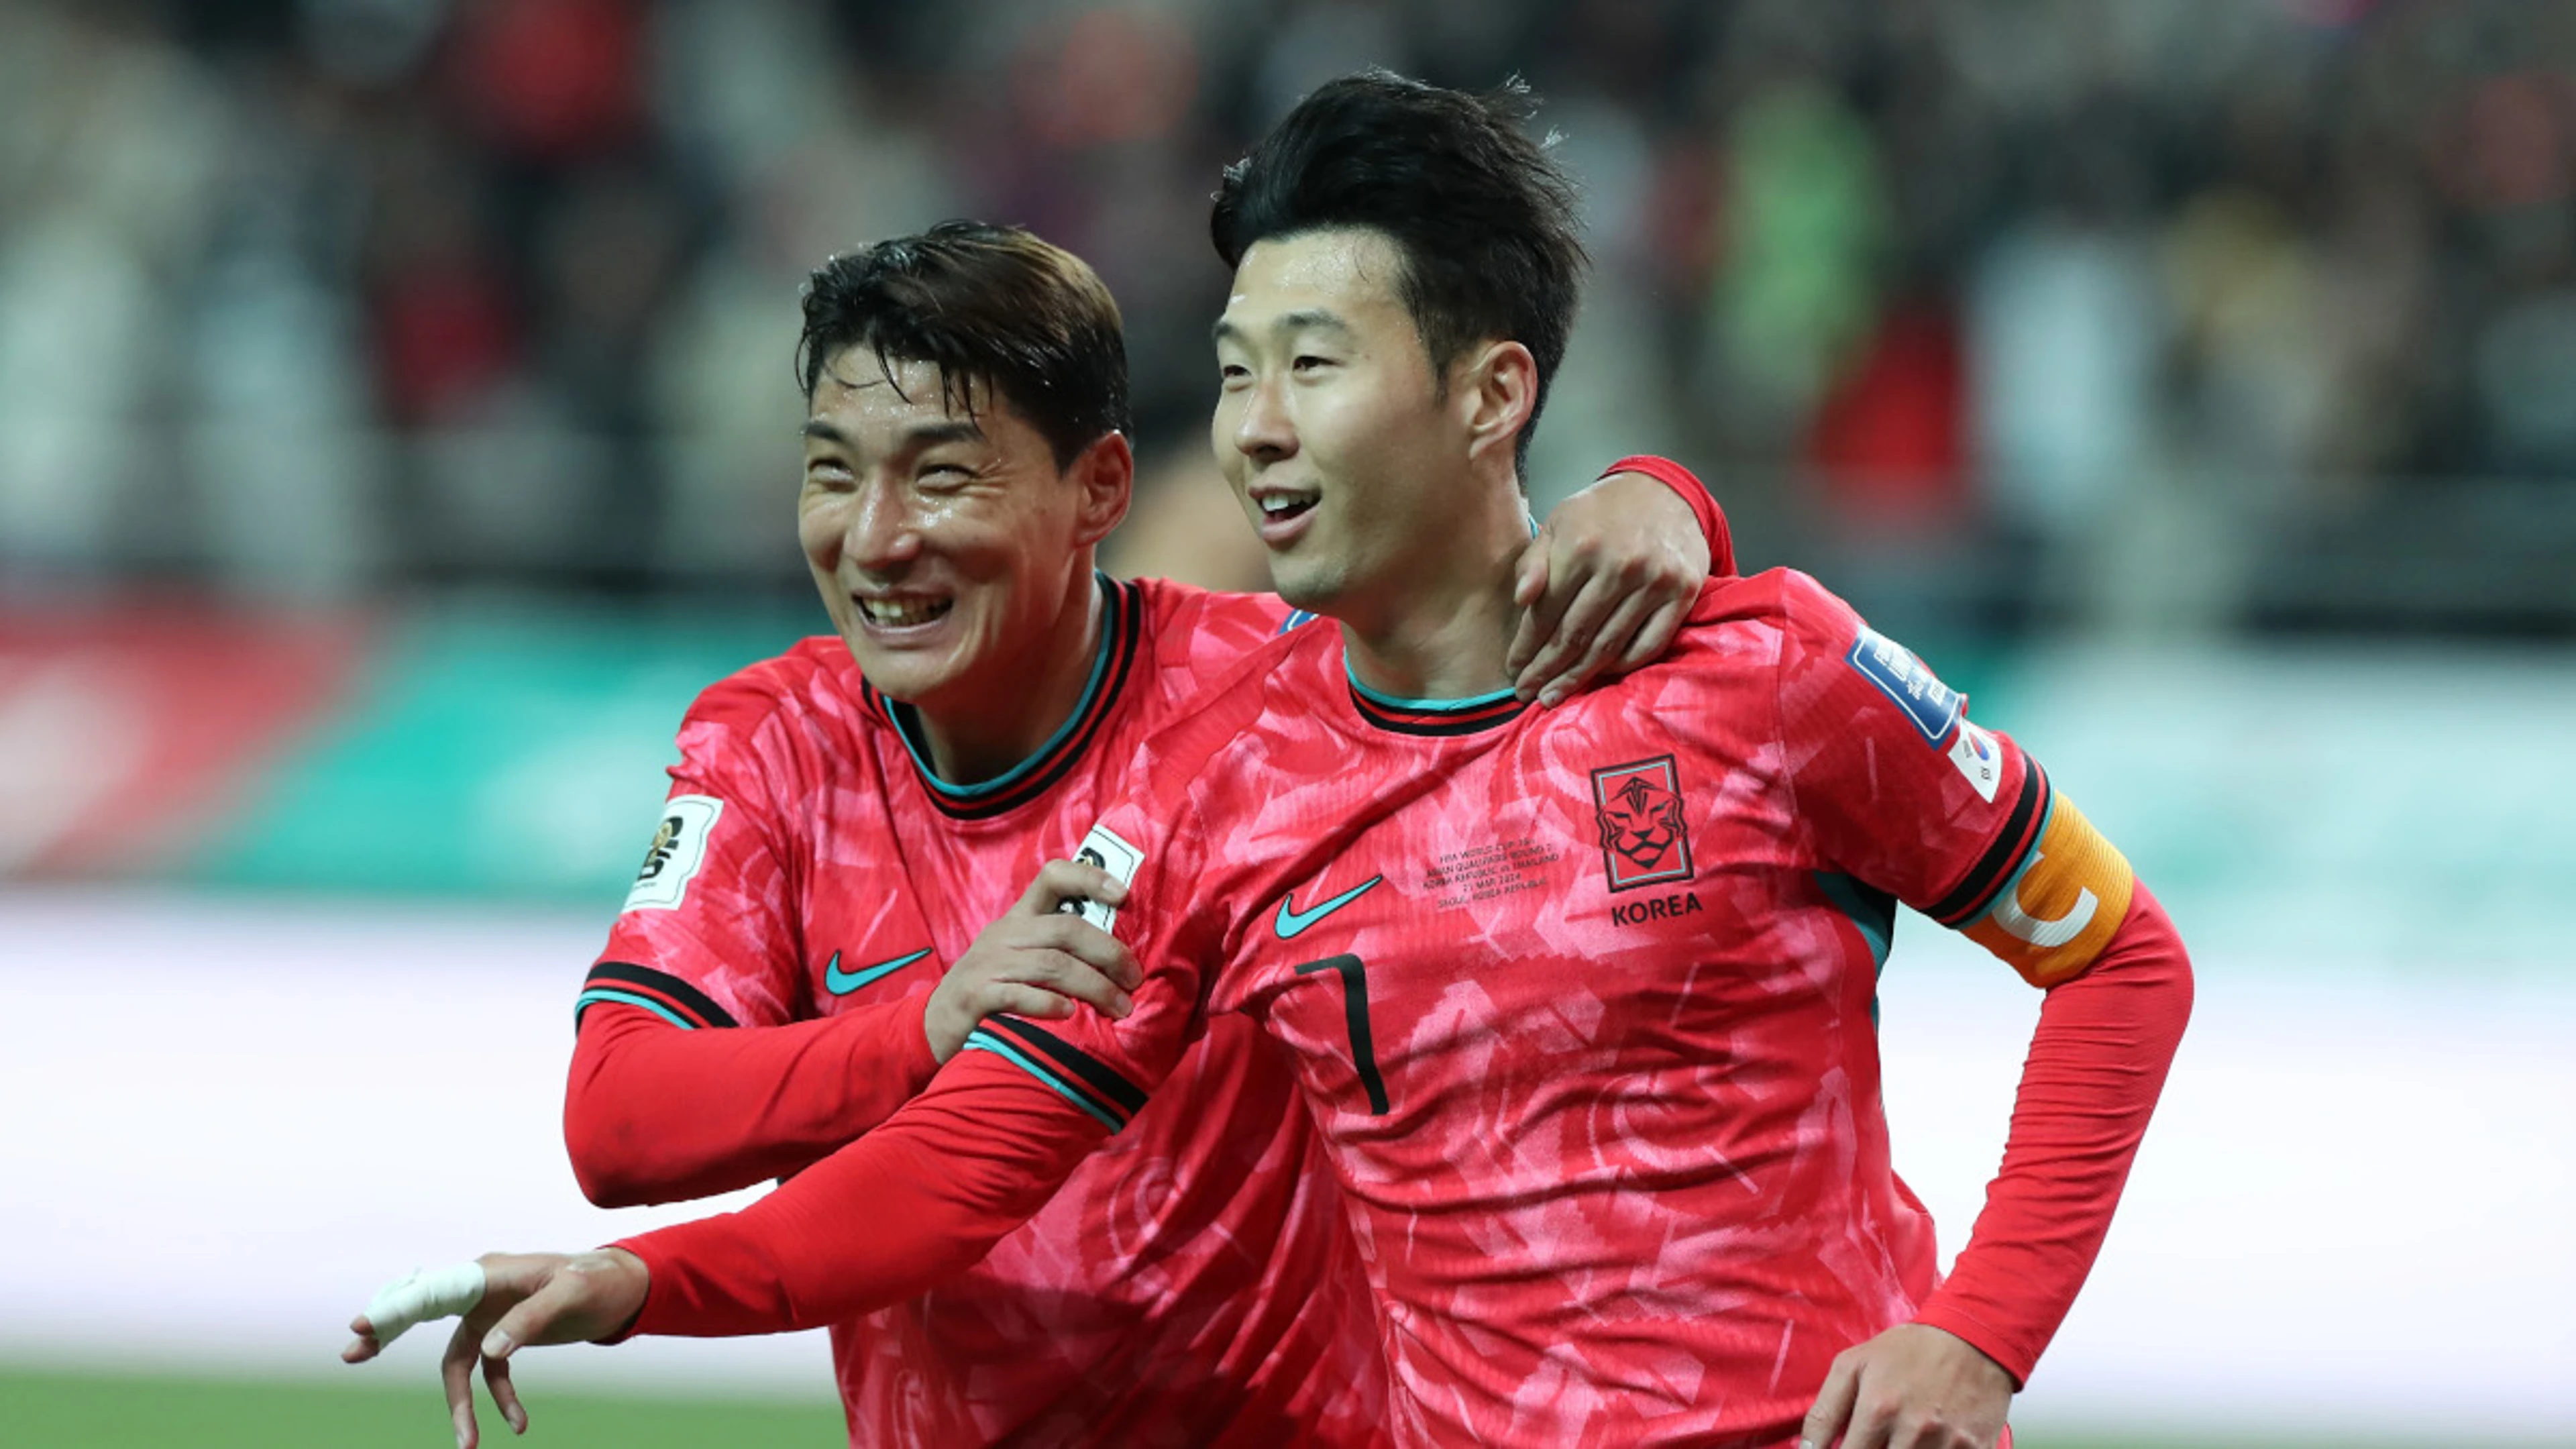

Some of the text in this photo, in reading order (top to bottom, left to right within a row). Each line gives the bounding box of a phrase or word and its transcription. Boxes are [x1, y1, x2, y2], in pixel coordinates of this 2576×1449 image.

[1427, 864, 1454, 877] ASIAN
[1511, 845, 1544, 859] ROUND
[1461, 846, 1493, 859] WORLD
[1495, 841, 1514, 852] CUP
[1423, 876, 1454, 890] KOREA
[1454, 867, 1496, 882] REPUBLIC
[1513, 854, 1559, 869] THAILAND
[1477, 877, 1497, 890] MAR
[1472, 888, 1501, 902] KOREA
[1504, 877, 1548, 894] REPUBLIC
[1991, 850, 2098, 948] C
[1612, 892, 1703, 927] KOREA
[1294, 953, 1389, 1116] 7
